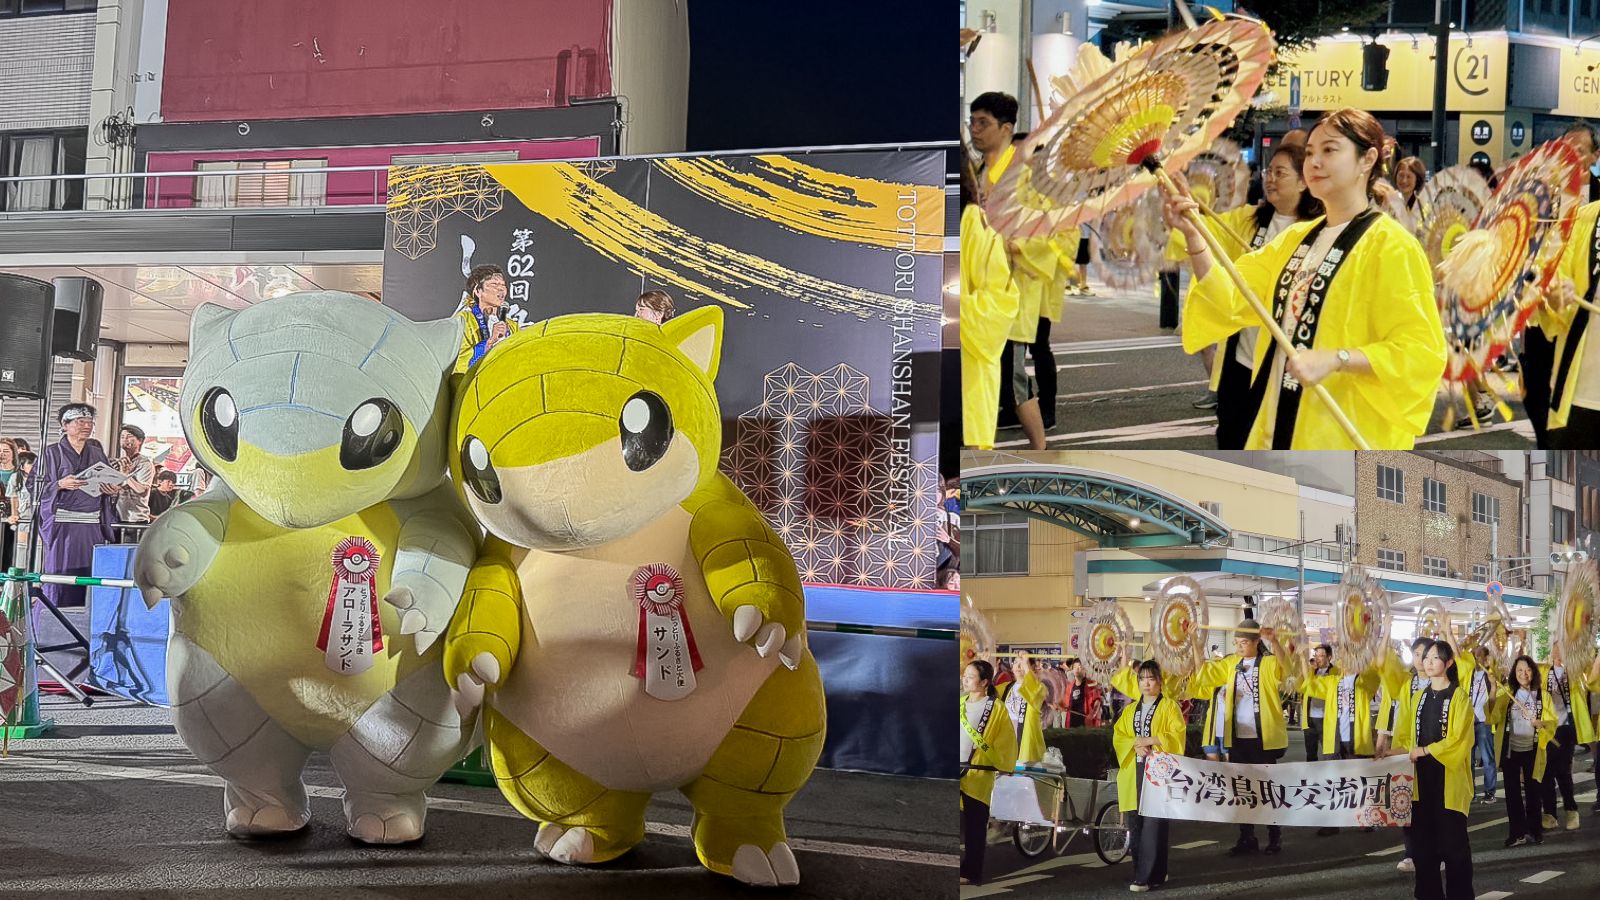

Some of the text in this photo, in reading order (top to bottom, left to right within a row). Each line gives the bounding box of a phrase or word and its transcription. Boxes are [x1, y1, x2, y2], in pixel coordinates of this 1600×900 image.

[1466, 54, 1489, 80] 21
[887, 189, 917, 551] TOTTORI SHANSHAN FESTIVAL
[339, 586, 356, 671] アローラサンド
[653, 626, 672, 680] サンド
[1164, 768, 1392, 811] 台湾鳥取交流団
